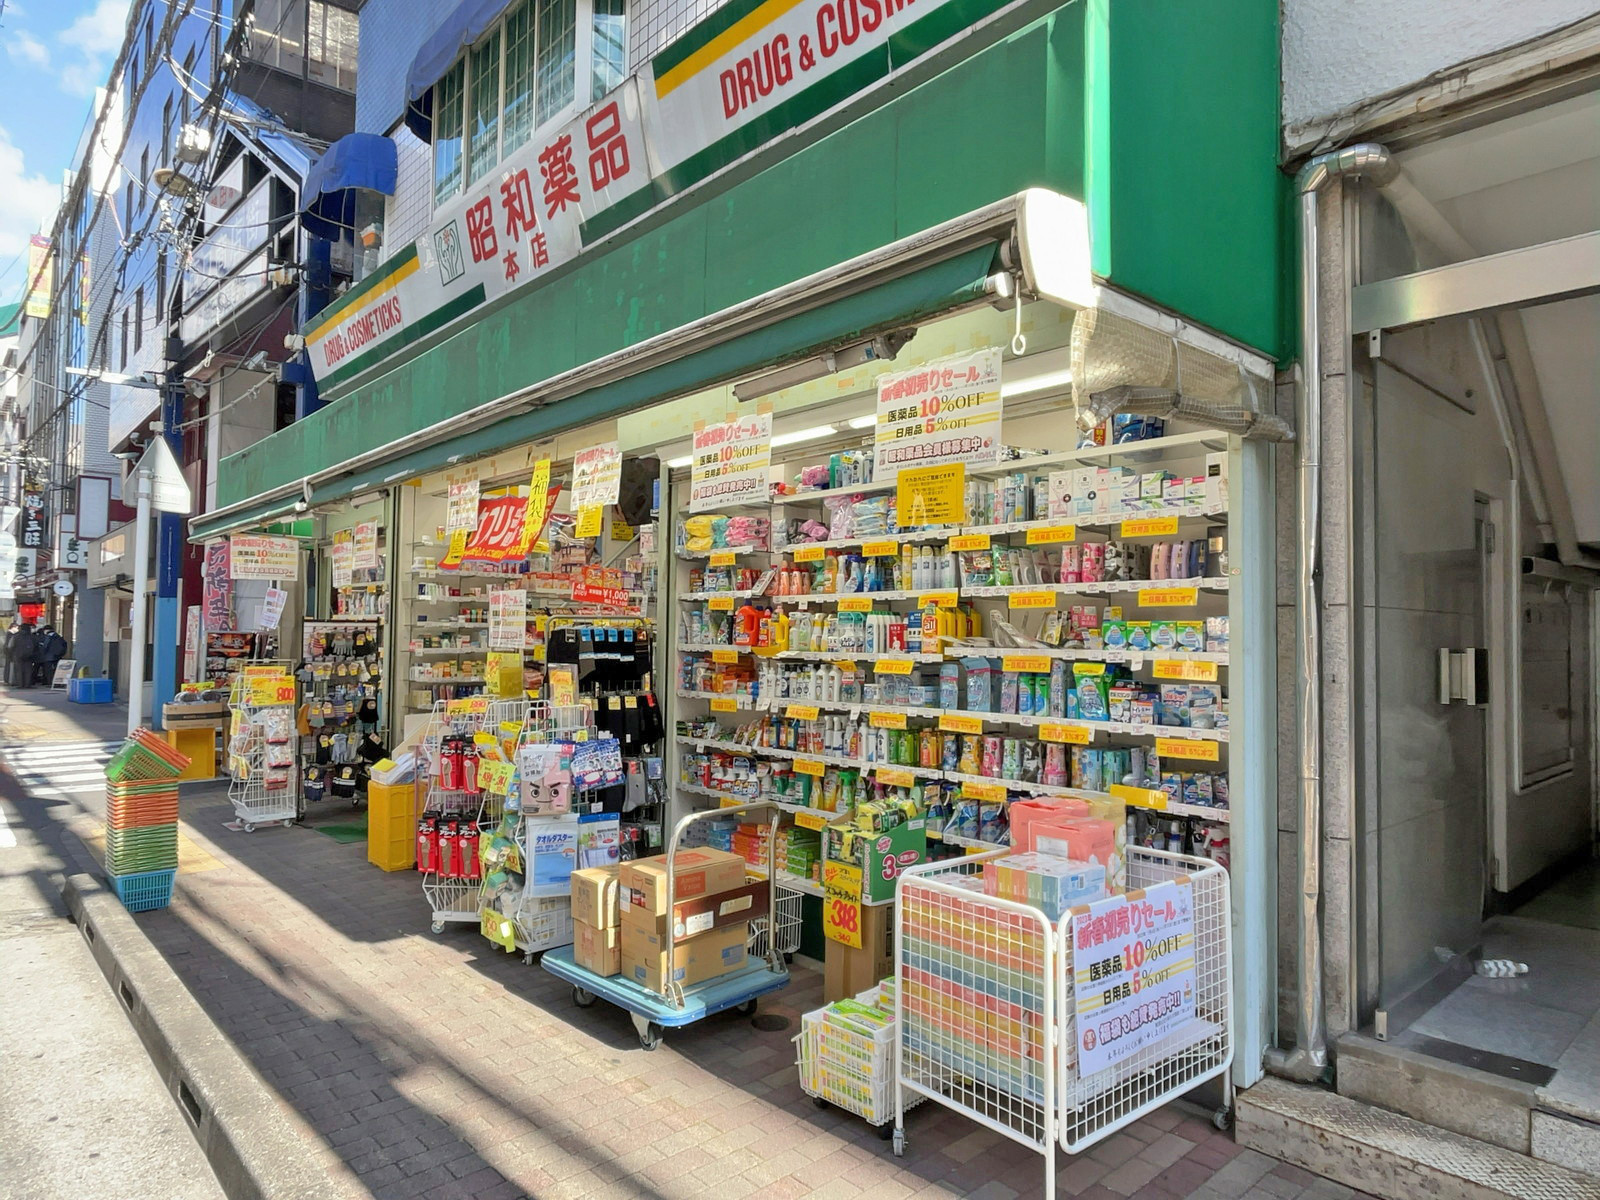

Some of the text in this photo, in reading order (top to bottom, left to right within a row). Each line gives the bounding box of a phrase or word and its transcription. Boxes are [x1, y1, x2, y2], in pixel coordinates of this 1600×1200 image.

[719, 0, 916, 119] DRUG & COS
[466, 101, 630, 264] 昭和薬品
[503, 232, 549, 283] 本店
[324, 334, 345, 367] DRUG
[347, 296, 402, 351] COSMETICKS
[881, 366, 980, 402] 新春初売りセール
[603, 589, 628, 600] ¥1,000
[277, 687, 294, 701] 800
[1077, 900, 1176, 950] 新春初売りセール
